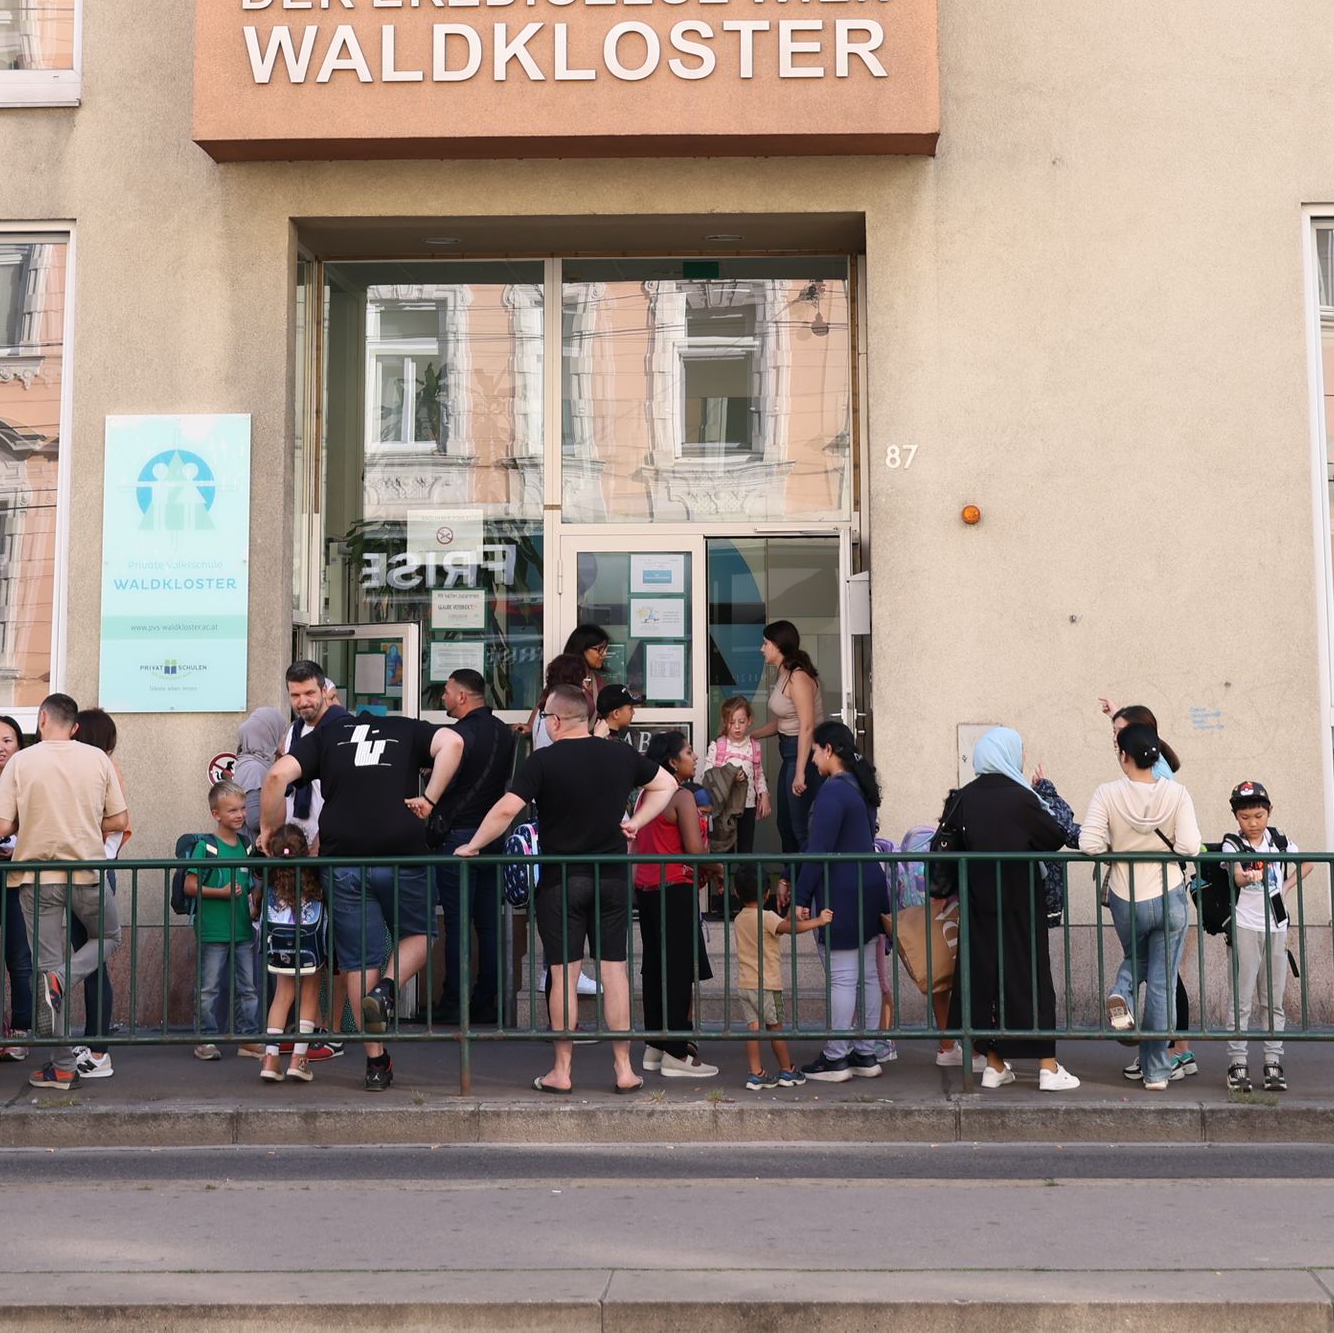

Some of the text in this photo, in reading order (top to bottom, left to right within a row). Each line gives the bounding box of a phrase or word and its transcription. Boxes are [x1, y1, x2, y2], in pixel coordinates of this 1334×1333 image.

[243, 18, 889, 85] WALDKLOSTER
[885, 444, 918, 469] 87
[113, 578, 237, 590] WALDKLOSTER
[130, 623, 218, 632] www.pvs-waldkloster.ac.at
